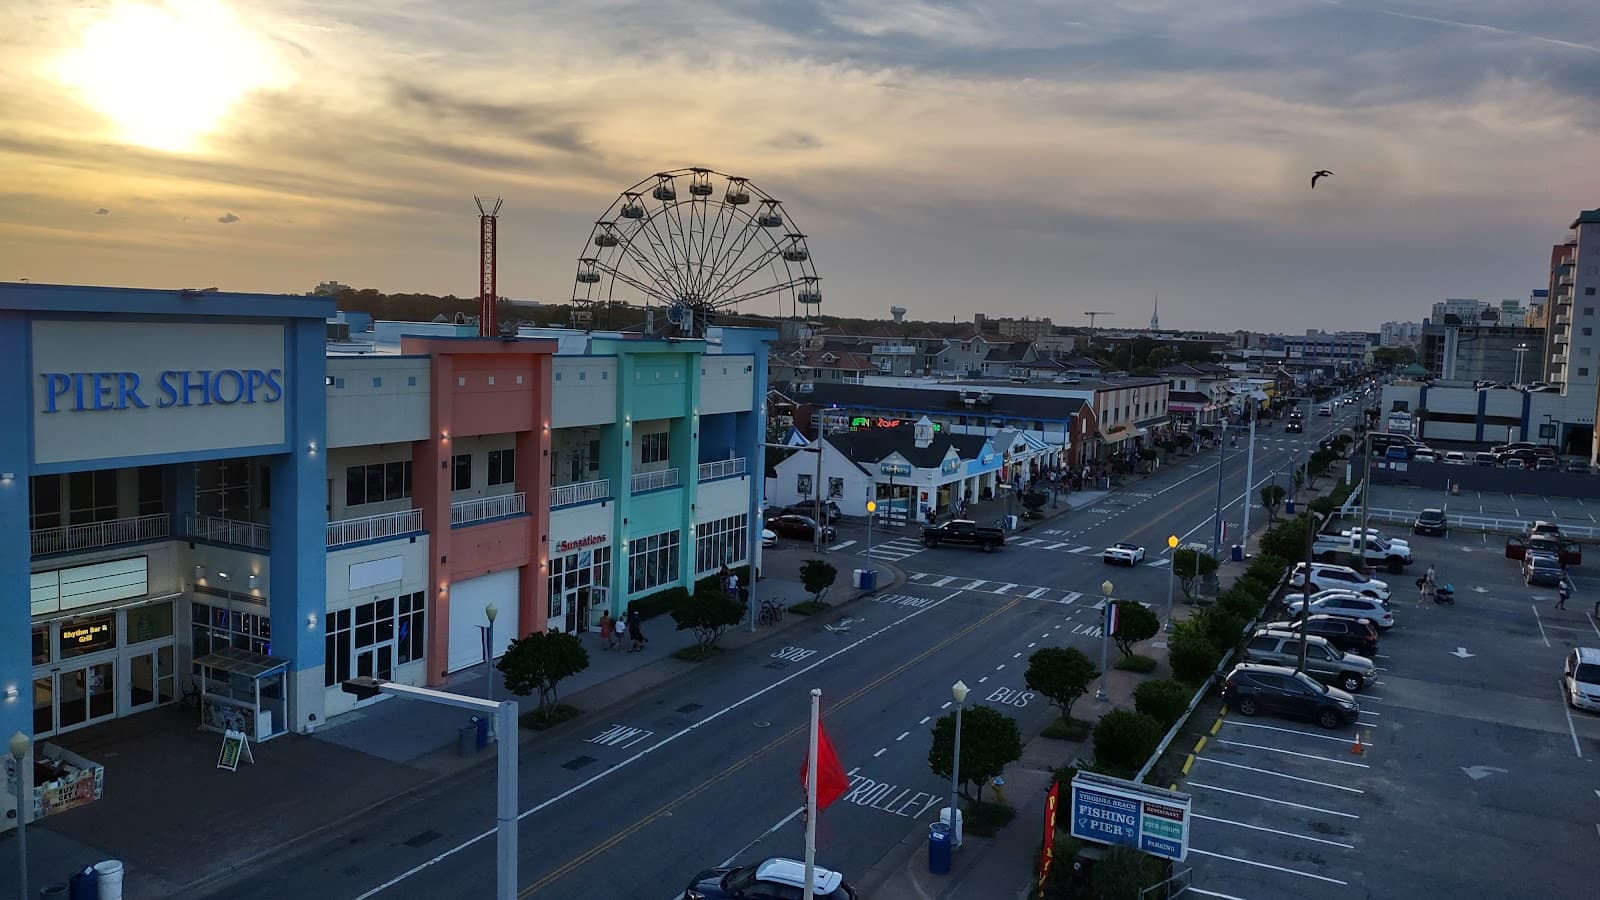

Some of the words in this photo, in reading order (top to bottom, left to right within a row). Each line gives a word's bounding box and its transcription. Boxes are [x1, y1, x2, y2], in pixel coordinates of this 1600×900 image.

[40, 370, 150, 414] PIER
[156, 368, 282, 409] SHOPS
[560, 534, 607, 552] Sunsations
[872, 593, 936, 609] TROLLEY
[63, 628, 89, 639] Rhythm
[89, 625, 101, 634] Bar
[771, 646, 817, 662] BUS
[986, 686, 1035, 709] BUS
[583, 722, 655, 749] LANE
[842, 774, 944, 820] TROLLEY
[1079, 793, 1112, 806] VIRGINIA
[1112, 799, 1137, 810] BEACH
[1078, 804, 1136, 826] FISHING
[1090, 819, 1123, 836] PIER
[1147, 839, 1175, 853] PARKING
